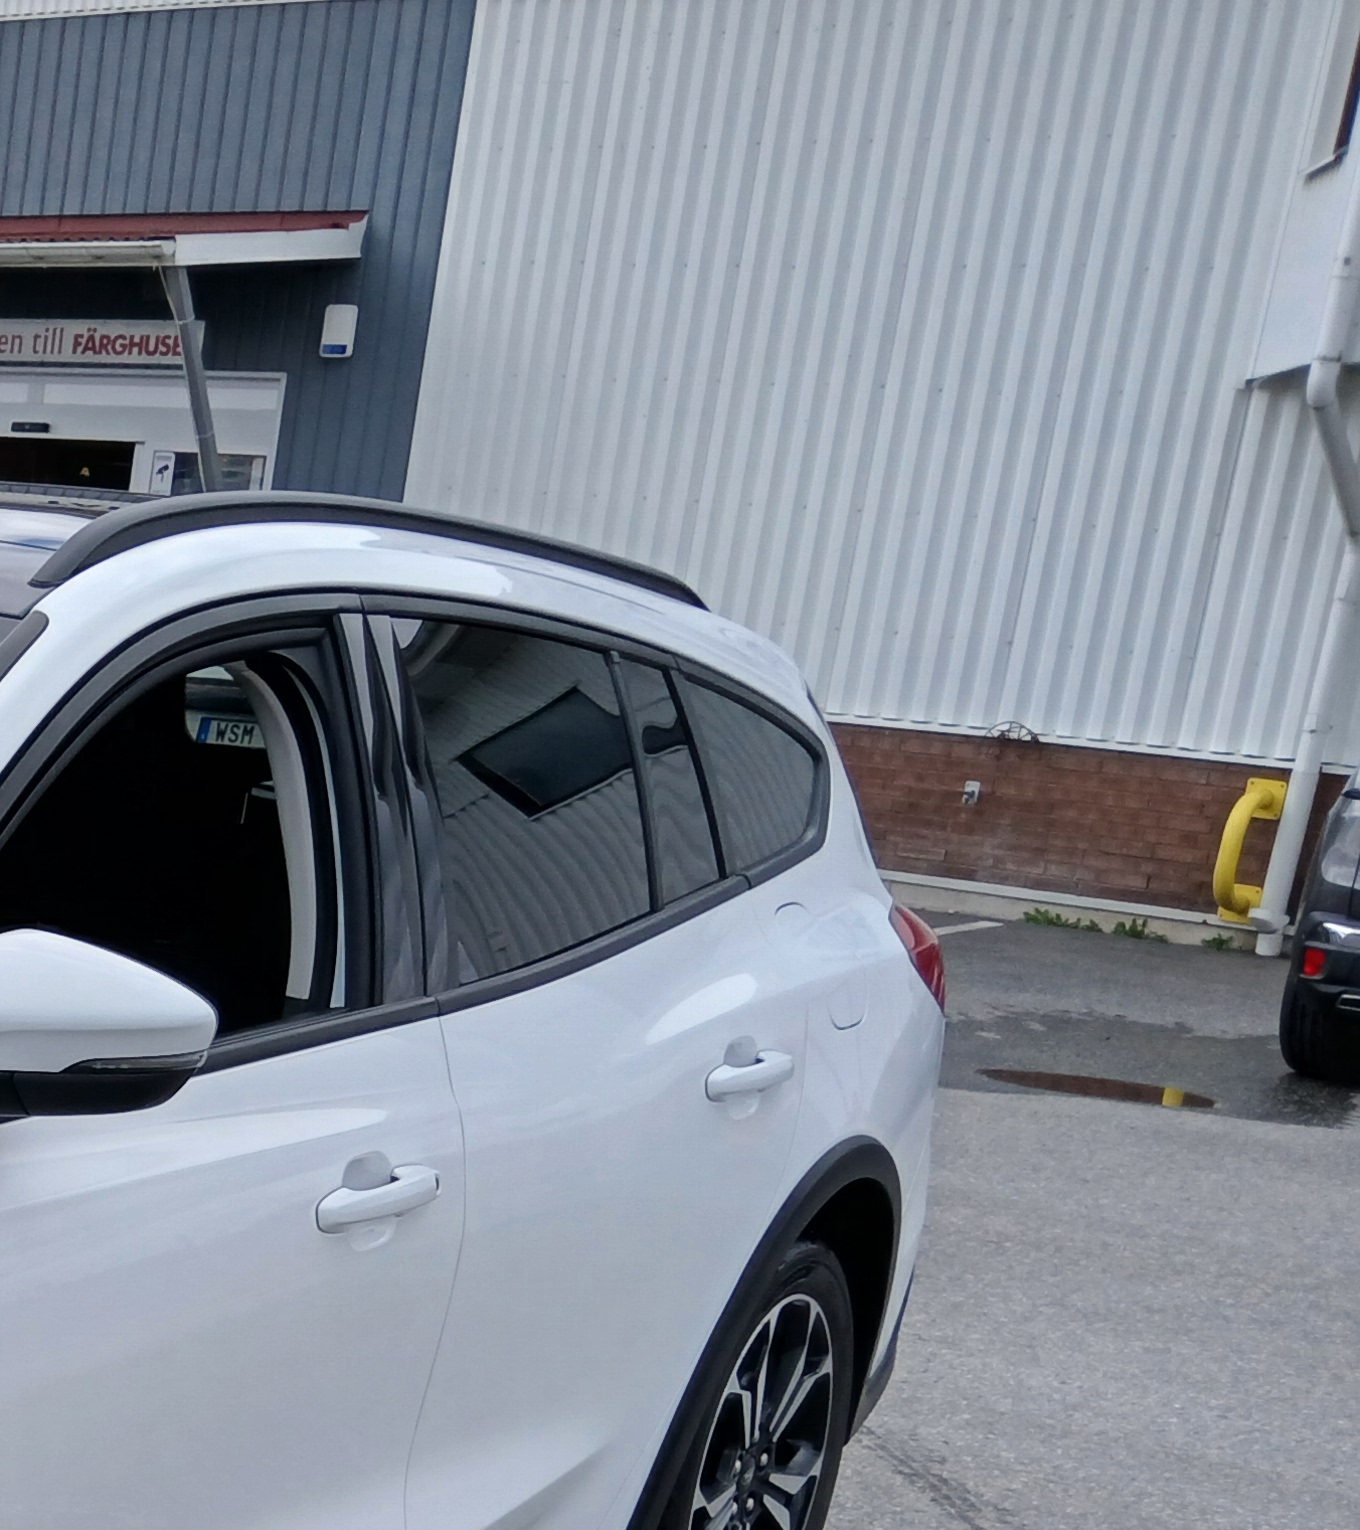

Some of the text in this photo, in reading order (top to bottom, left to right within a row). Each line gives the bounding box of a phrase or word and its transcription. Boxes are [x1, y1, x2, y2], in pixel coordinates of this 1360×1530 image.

[31, 327, 65, 355] till
[71, 326, 183, 357] FÄRGHUSE
[215, 721, 256, 745] WSM
